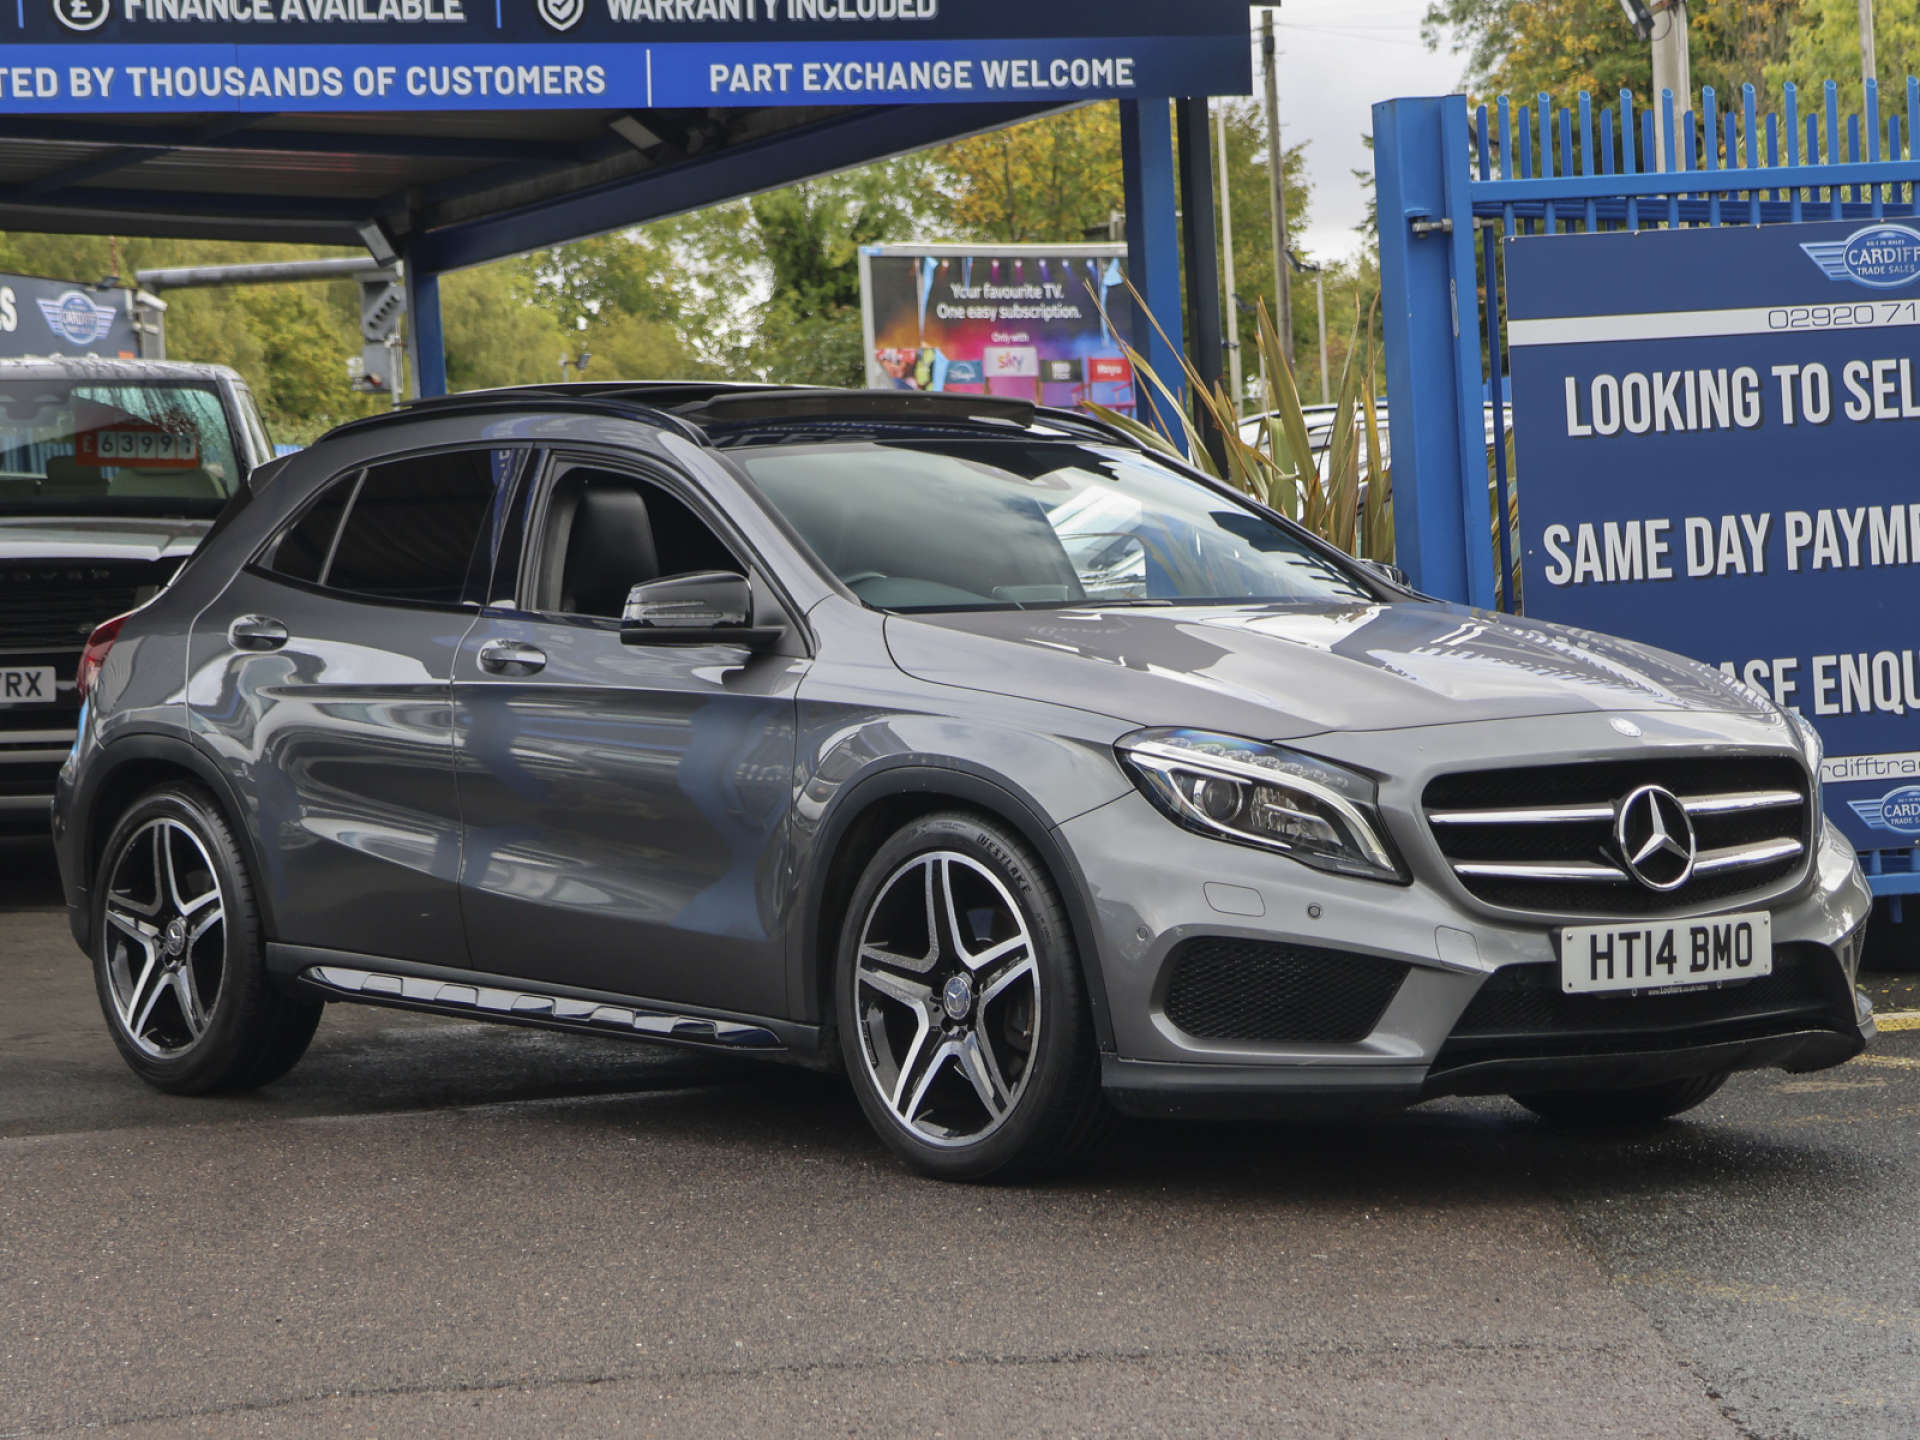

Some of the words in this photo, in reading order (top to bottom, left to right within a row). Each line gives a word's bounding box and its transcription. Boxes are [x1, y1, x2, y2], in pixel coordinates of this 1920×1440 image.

[124, 0, 276, 22] FINANCE
[281, 0, 465, 22] AVAILABLE
[607, 0, 781, 22] WARRANTY
[788, 0, 938, 21] INCLUDED
[69, 67, 114, 97] BY
[126, 66, 343, 97] THOUSANDS
[353, 66, 396, 96] OF
[405, 65, 606, 96] CUSTOMERS
[709, 63, 794, 92] PART
[803, 61, 974, 92] EXCHANGE
[981, 57, 1136, 88] WELCOME
[1848, 246, 1920, 266] CARDIFF
[1857, 266, 1886, 276] TRADE
[1888, 263, 1915, 273] SALES
[950, 282, 982, 299] Your
[983, 281, 1043, 299] favourite
[936, 302, 966, 319] One
[966, 304, 998, 322] easy
[998, 302, 1082, 322] subscription.
[1768, 305, 1874, 330] 02920
[1881, 302, 1916, 323] 71
[1565, 366, 1761, 436] LOOKING
[1771, 362, 1831, 425] TO
[1843, 358, 1920, 421] SEL
[1543, 519, 1673, 585] SAME
[1685, 513, 1771, 576] DAY
[0, 671, 42, 697] RX
[1590, 929, 1677, 980] HT14
[1689, 922, 1752, 973] BMO
